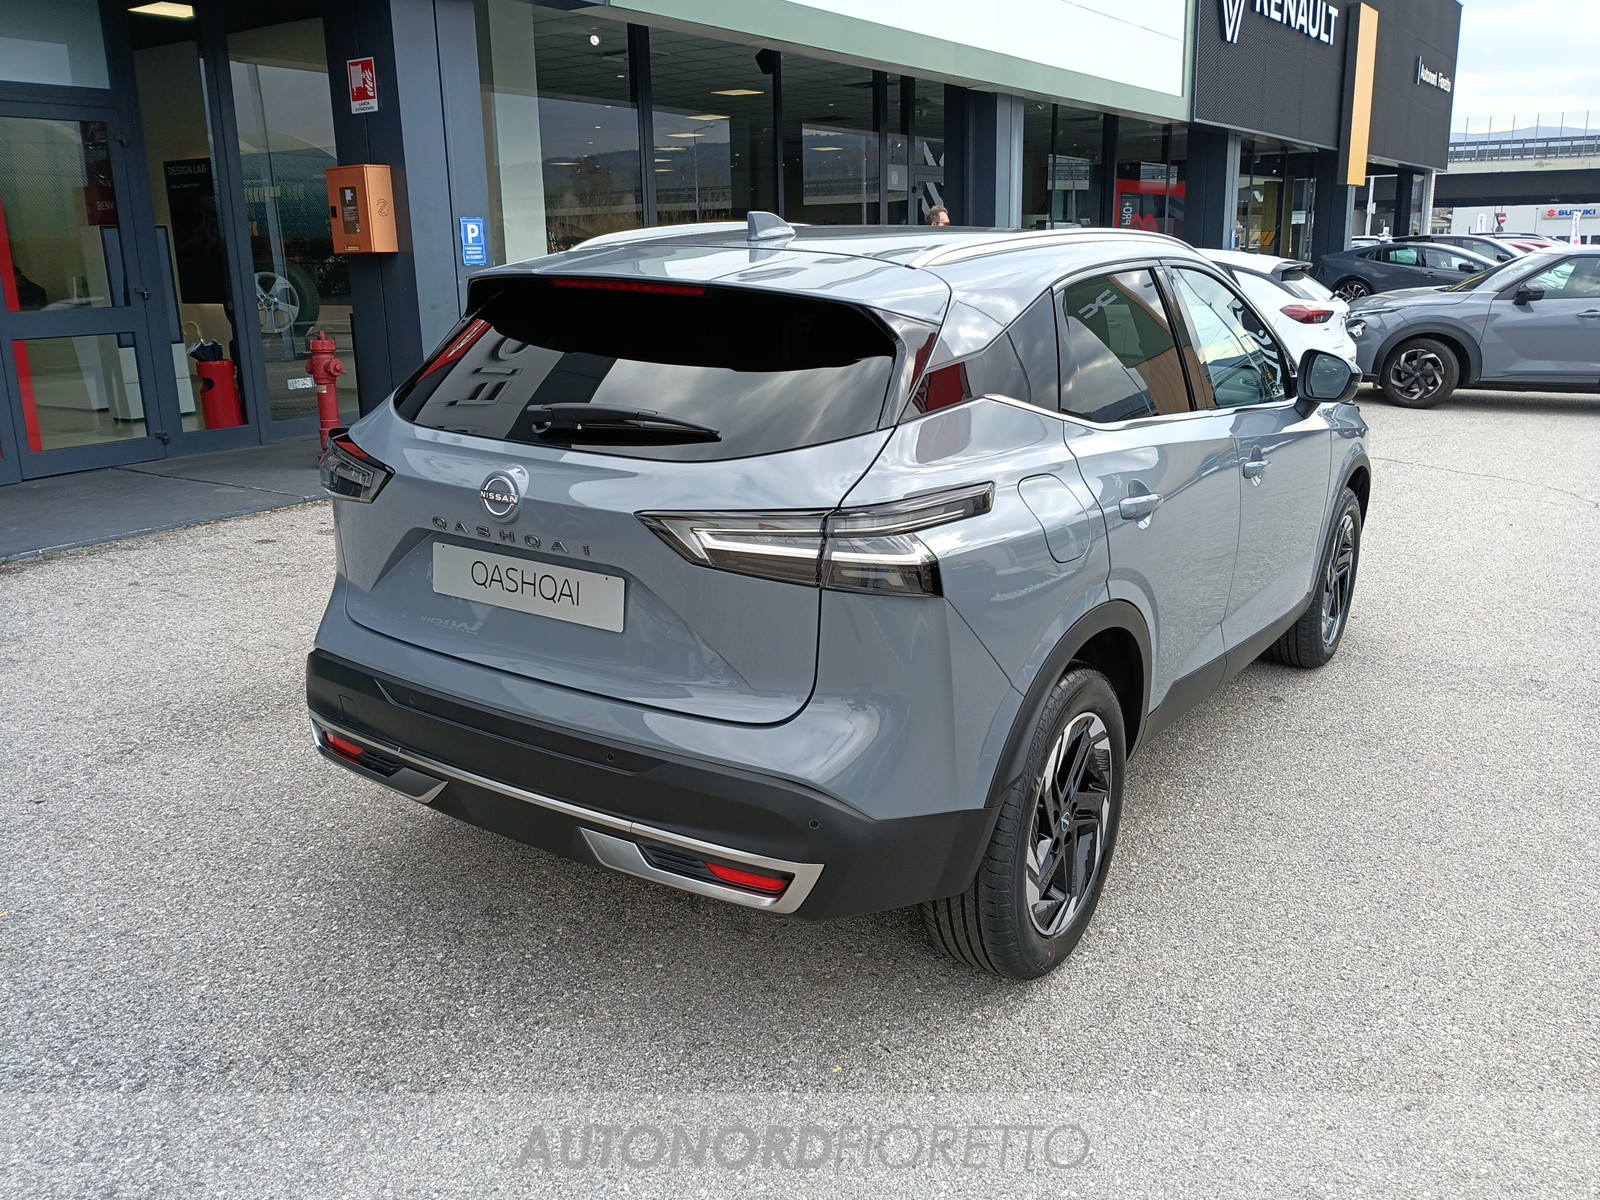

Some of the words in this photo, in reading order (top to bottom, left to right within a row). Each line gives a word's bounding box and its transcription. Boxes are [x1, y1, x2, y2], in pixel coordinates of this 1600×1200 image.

[467, 224, 479, 244] P
[480, 490, 518, 504] NISSAN
[432, 516, 590, 556] QASHQAI
[471, 560, 580, 607] QASHQAI
